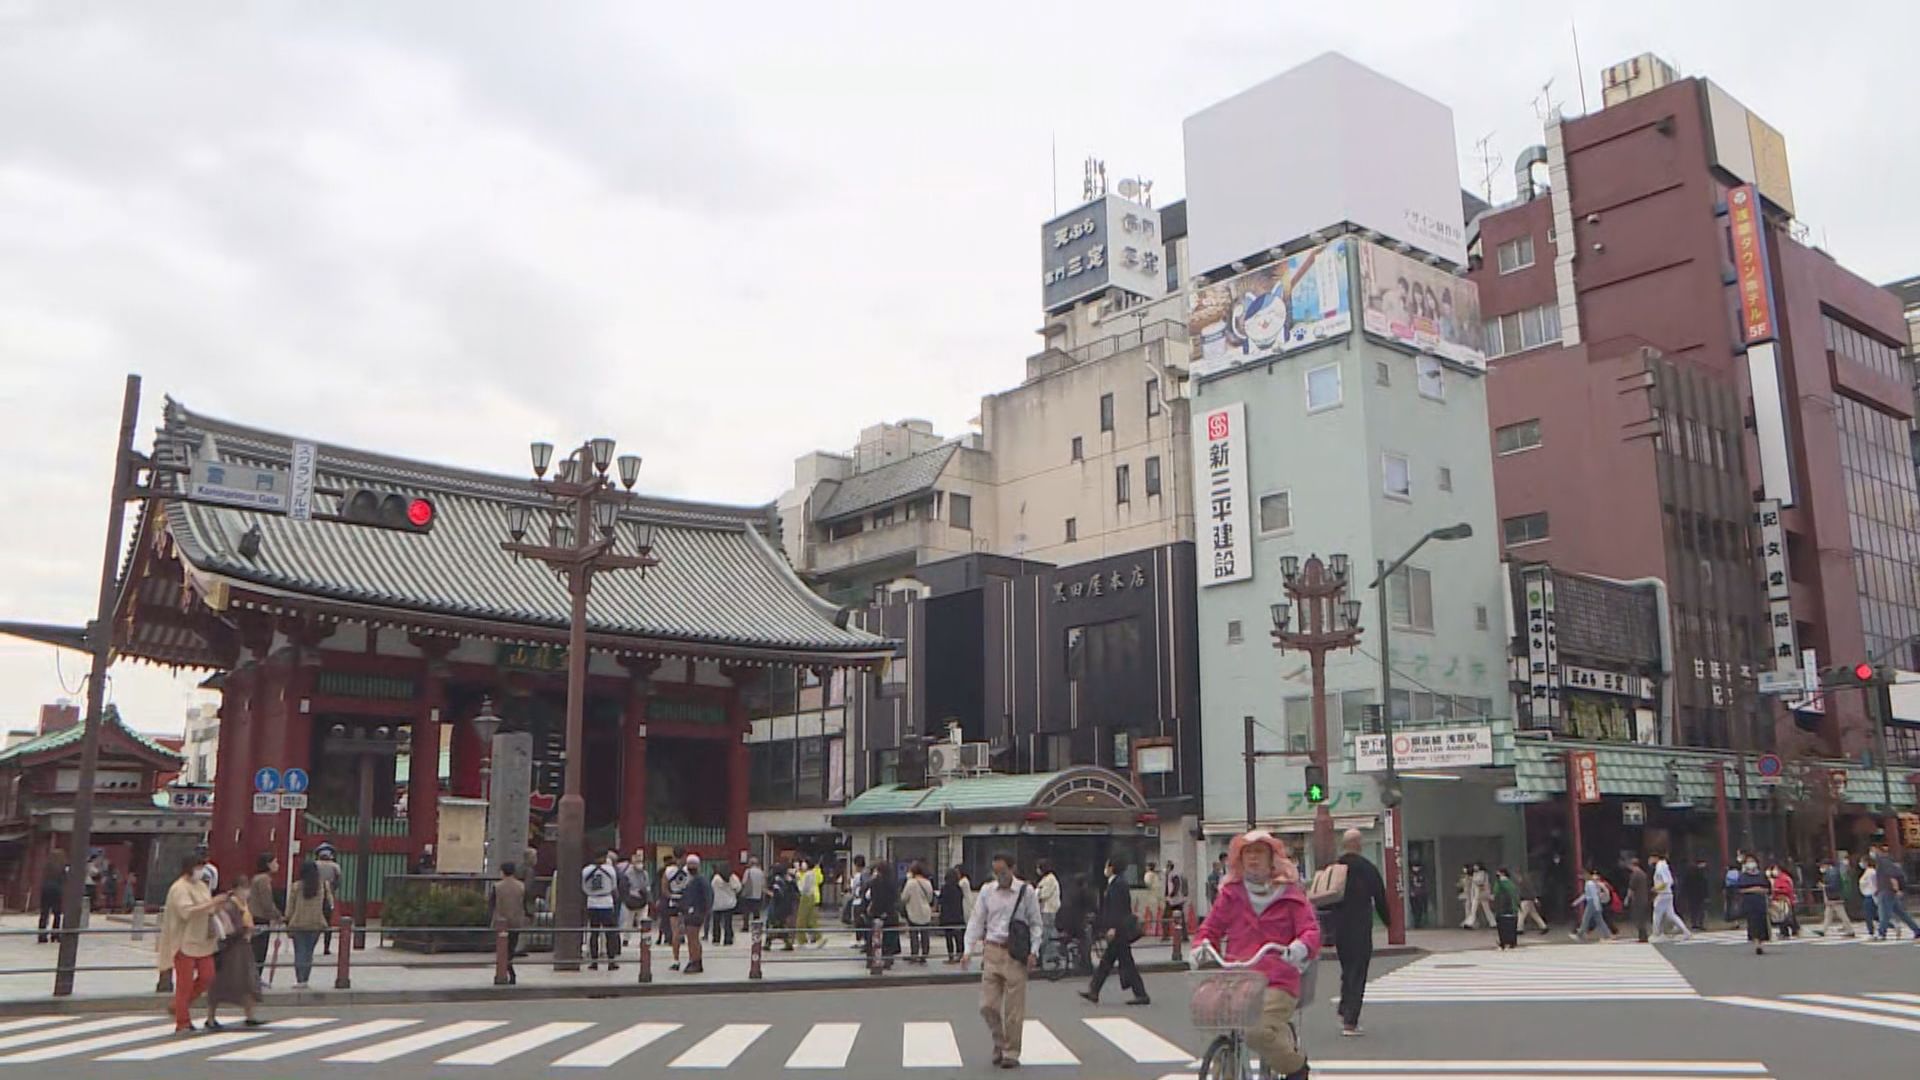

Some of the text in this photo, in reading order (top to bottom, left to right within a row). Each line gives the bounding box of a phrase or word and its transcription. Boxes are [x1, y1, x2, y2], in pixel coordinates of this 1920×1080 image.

[1054, 217, 1096, 249] 天ぷら
[1749, 323, 1767, 337] 5F
[1209, 441, 1235, 579] 新三平建設
[1051, 563, 1145, 604] 黒田屋本店
